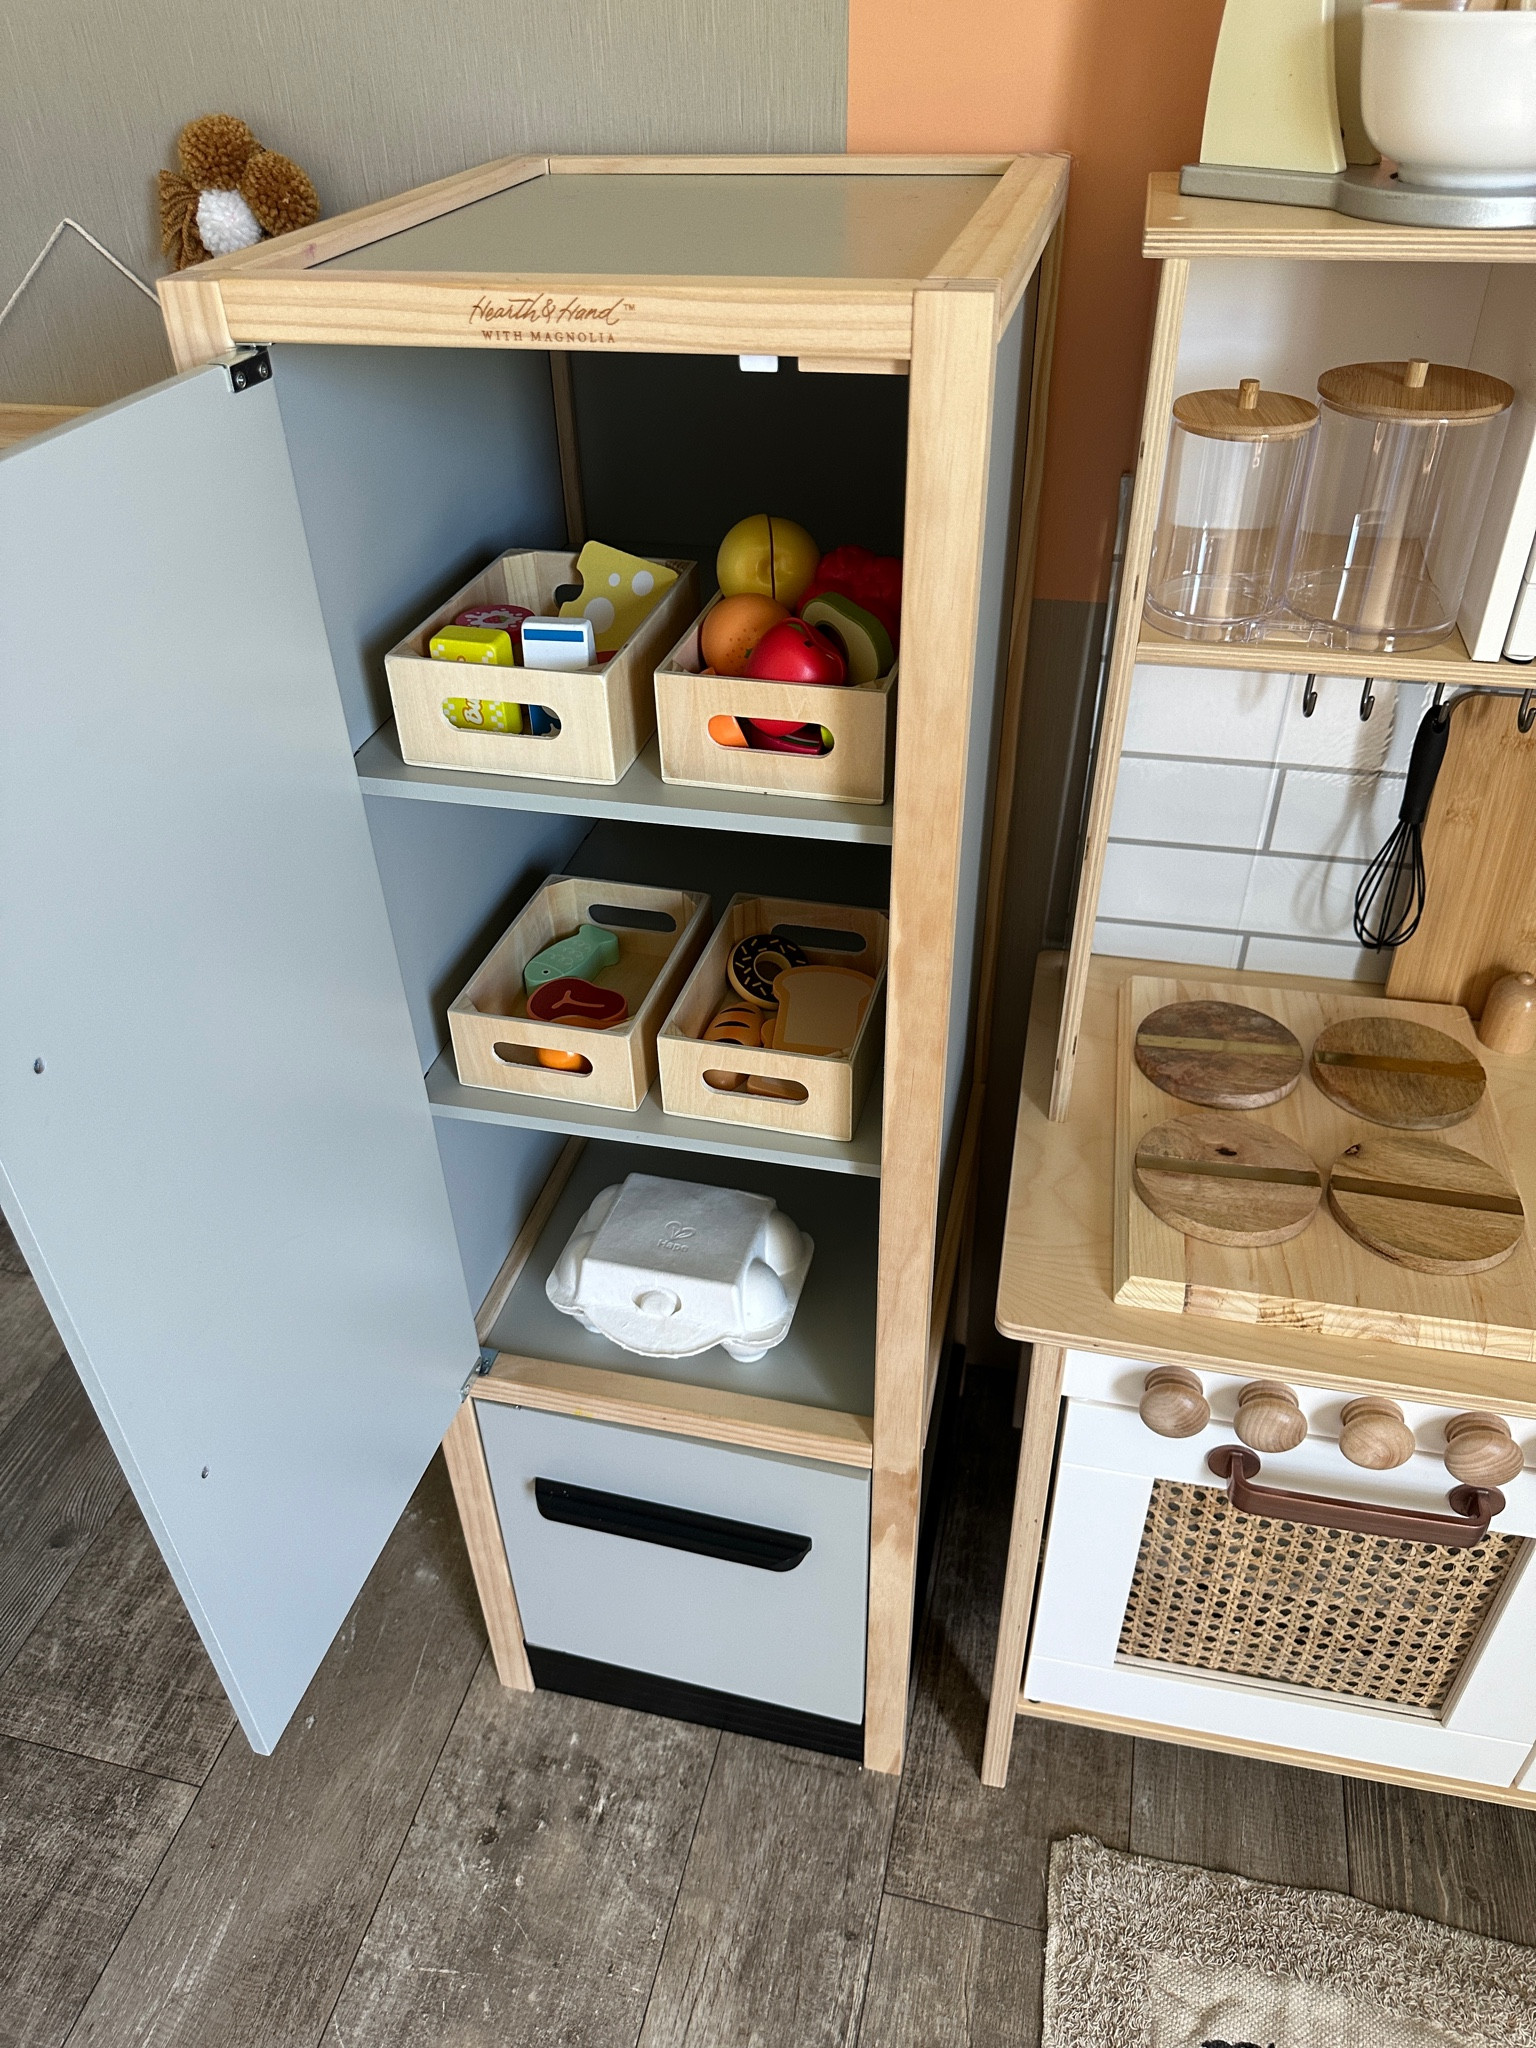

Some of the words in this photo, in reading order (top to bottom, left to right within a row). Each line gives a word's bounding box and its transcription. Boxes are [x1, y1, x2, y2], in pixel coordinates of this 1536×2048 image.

[468, 292, 543, 325] Hearth
[541, 298, 556, 324] &
[481, 330, 523, 342] WITH
[530, 330, 616, 344] MAGNOLIA
